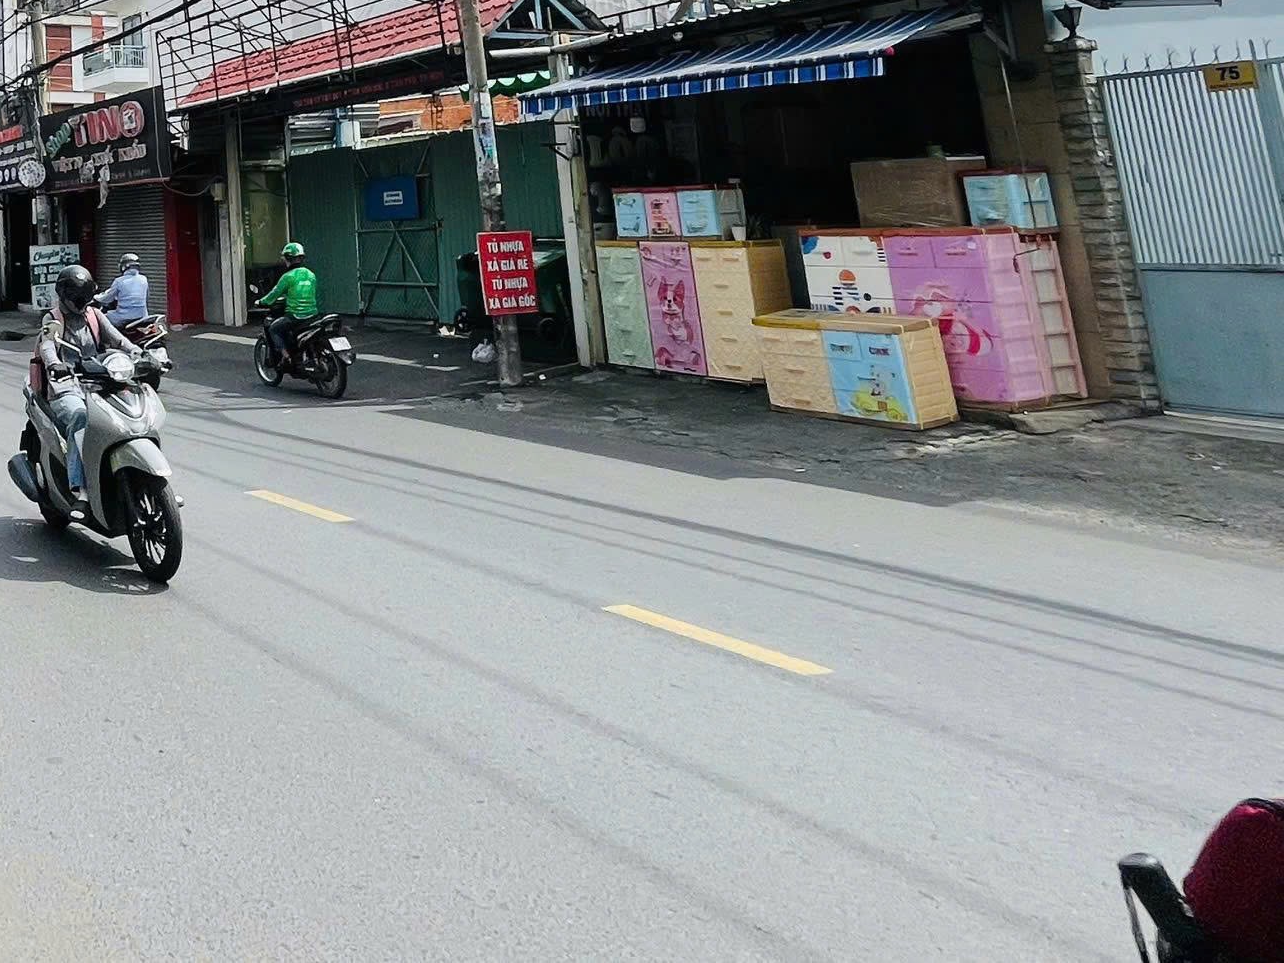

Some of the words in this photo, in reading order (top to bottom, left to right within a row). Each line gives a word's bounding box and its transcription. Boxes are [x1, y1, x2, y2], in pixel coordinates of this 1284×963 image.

[1215, 65, 1240, 81] 75
[68, 100, 145, 148] TINO
[486, 238, 499, 254] TỦ
[499, 240, 525, 255] NHỰA
[500, 256, 516, 271] GIÁ
[491, 275, 503, 291] TỦ
[503, 276, 529, 292] NHỰA
[501, 293, 517, 309] GIÁ
